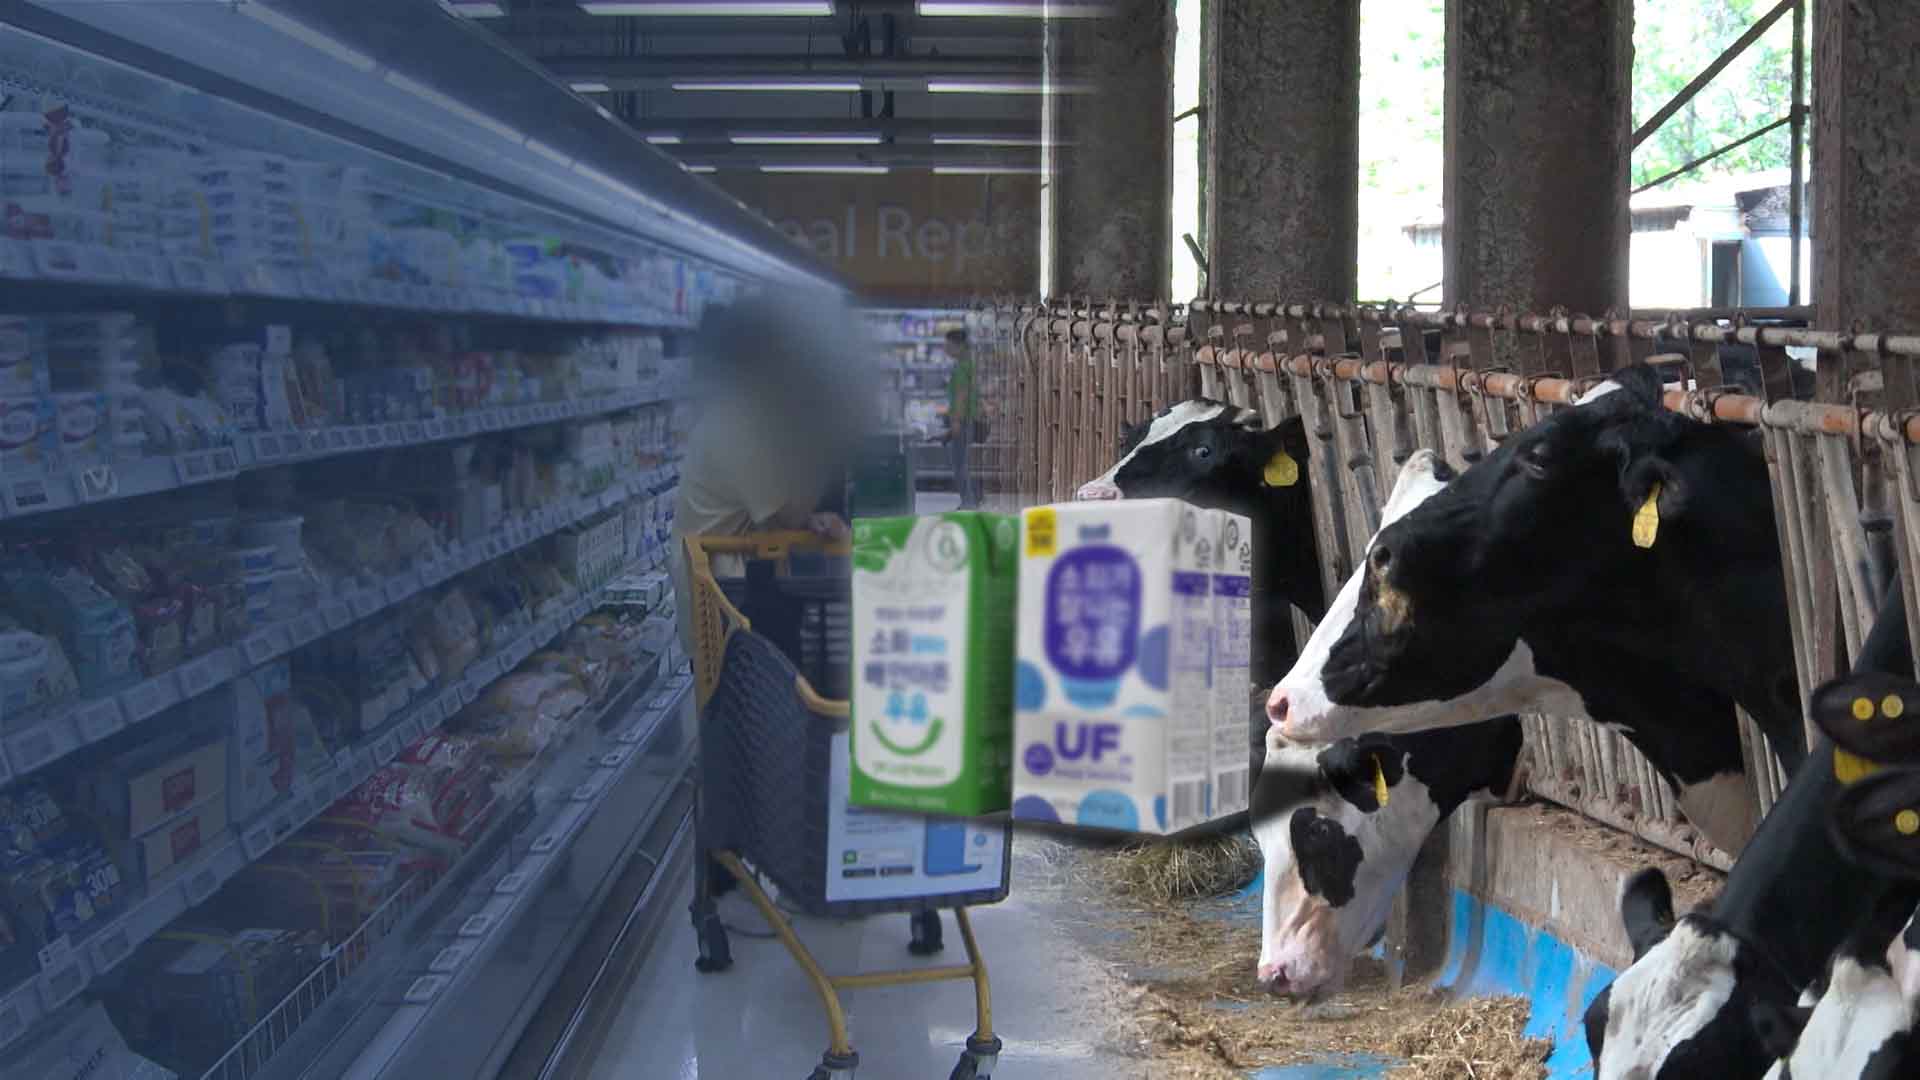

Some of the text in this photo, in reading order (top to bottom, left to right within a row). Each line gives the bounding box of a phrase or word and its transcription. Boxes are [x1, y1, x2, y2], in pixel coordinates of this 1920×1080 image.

[756, 204, 1004, 274] eal Rep
[1059, 626, 1126, 667] 우유
[1055, 721, 1122, 761] UF
